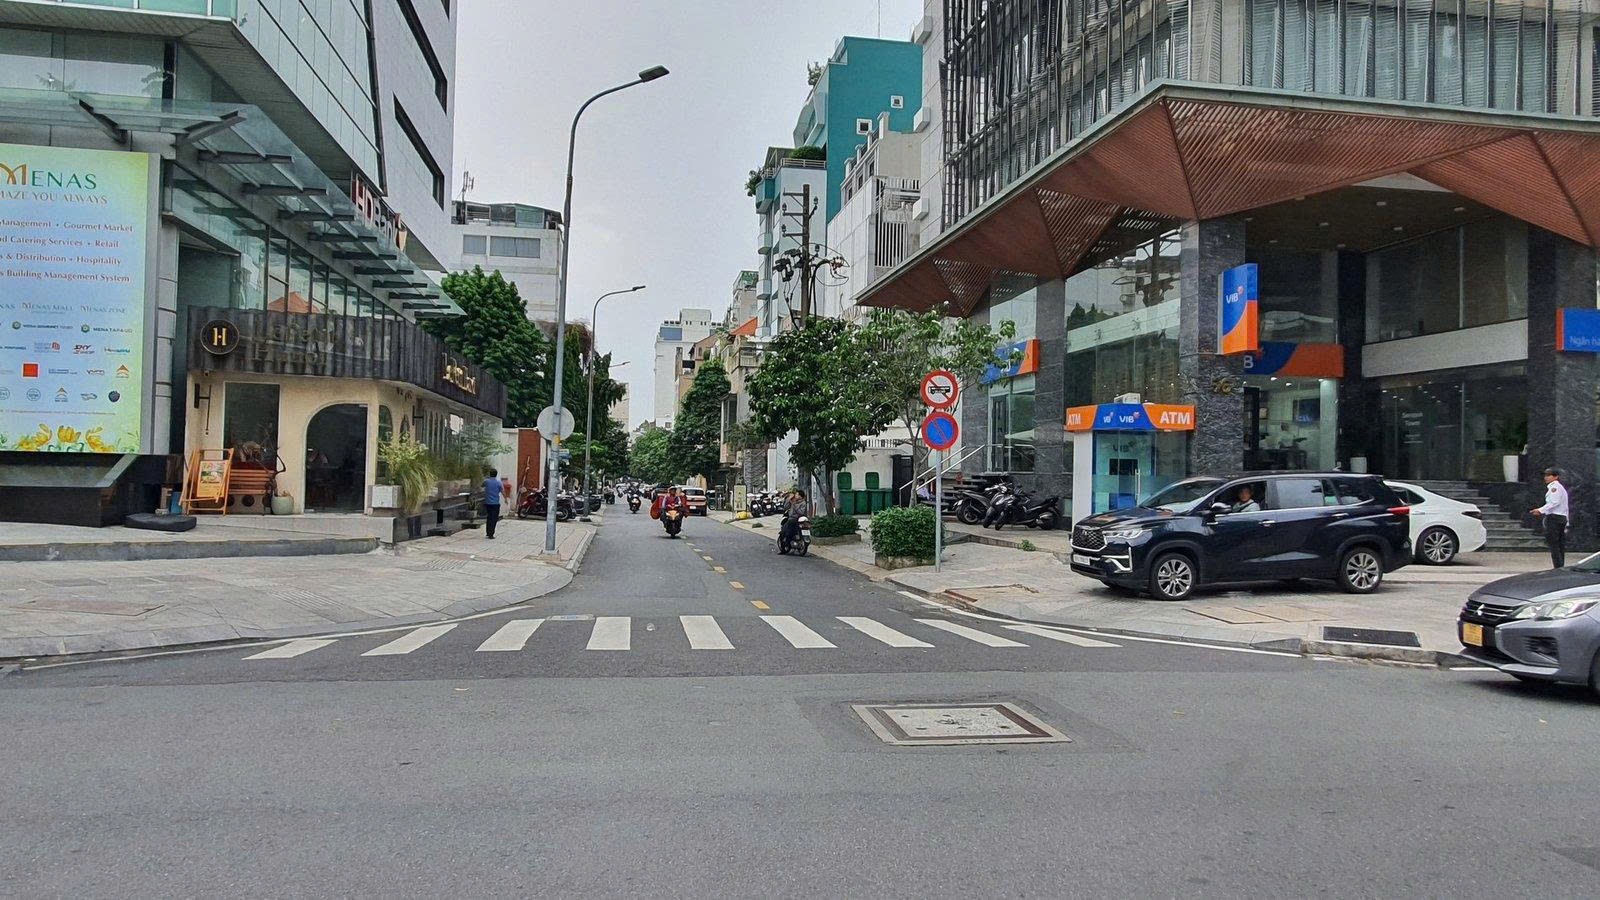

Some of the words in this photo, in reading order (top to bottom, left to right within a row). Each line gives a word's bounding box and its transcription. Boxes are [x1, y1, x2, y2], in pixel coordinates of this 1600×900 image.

[33, 191, 58, 201] YOU
[64, 193, 108, 205] ALWAYS
[63, 221, 101, 230] Gourmet
[104, 224, 133, 232] Market
[11, 236, 47, 246] Catering
[48, 238, 83, 246] Services
[95, 239, 119, 248] Retail
[16, 252, 67, 262] Distribution
[76, 256, 122, 266] Hospitality
[6, 269, 42, 279] Building
[43, 271, 98, 281] Management
[100, 273, 130, 283] System
[1225, 292, 1239, 304] VIB
[213, 327, 227, 346] H
[1067, 413, 1081, 425] ATM
[1119, 415, 1134, 423] VIB
[1160, 411, 1191, 425] ATM
